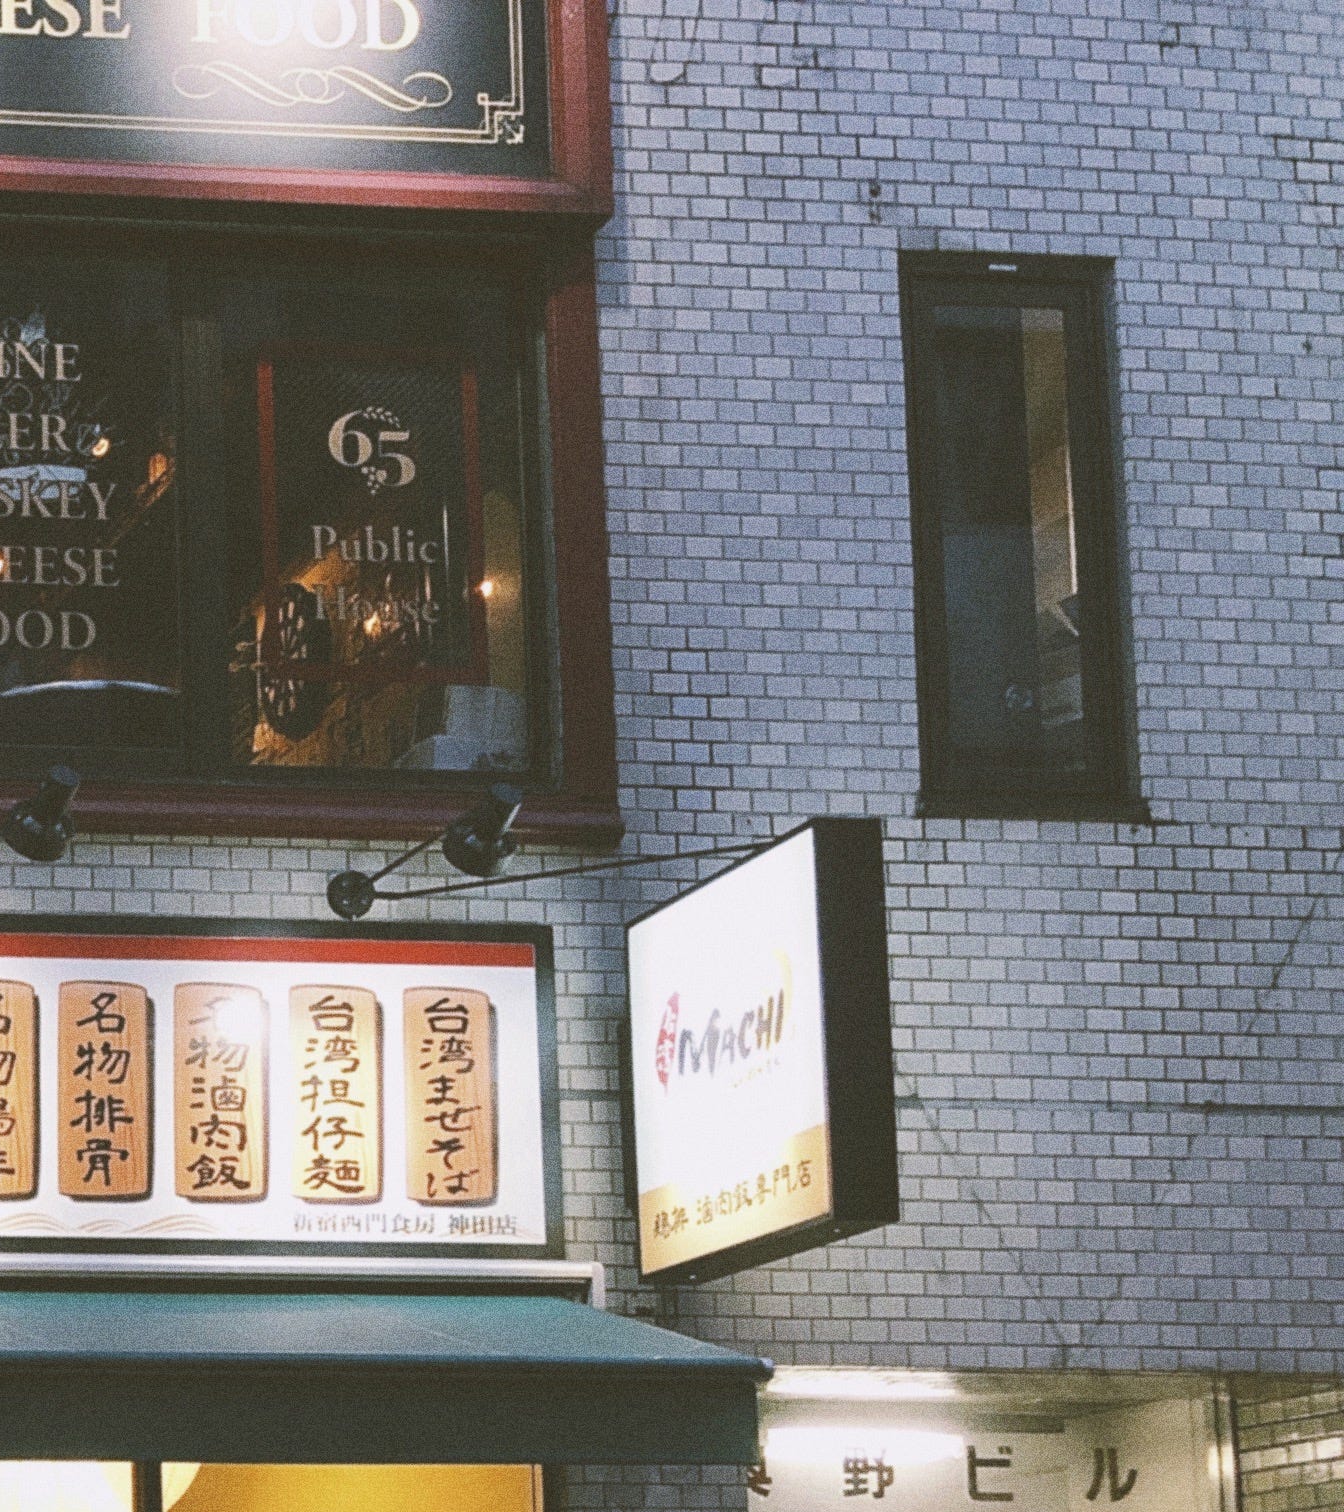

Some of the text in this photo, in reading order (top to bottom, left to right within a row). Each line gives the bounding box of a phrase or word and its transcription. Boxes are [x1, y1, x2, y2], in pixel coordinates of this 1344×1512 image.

[192, 0, 421, 53] FOOD
[329, 409, 416, 488] 65
[313, 525, 439, 564] Public
[678, 988, 785, 1080] MACHI
[70, 991, 135, 1187] 名物排骨
[419, 996, 483, 1200] 台湾まぜそば
[448, 1213, 518, 1237] 神田店
